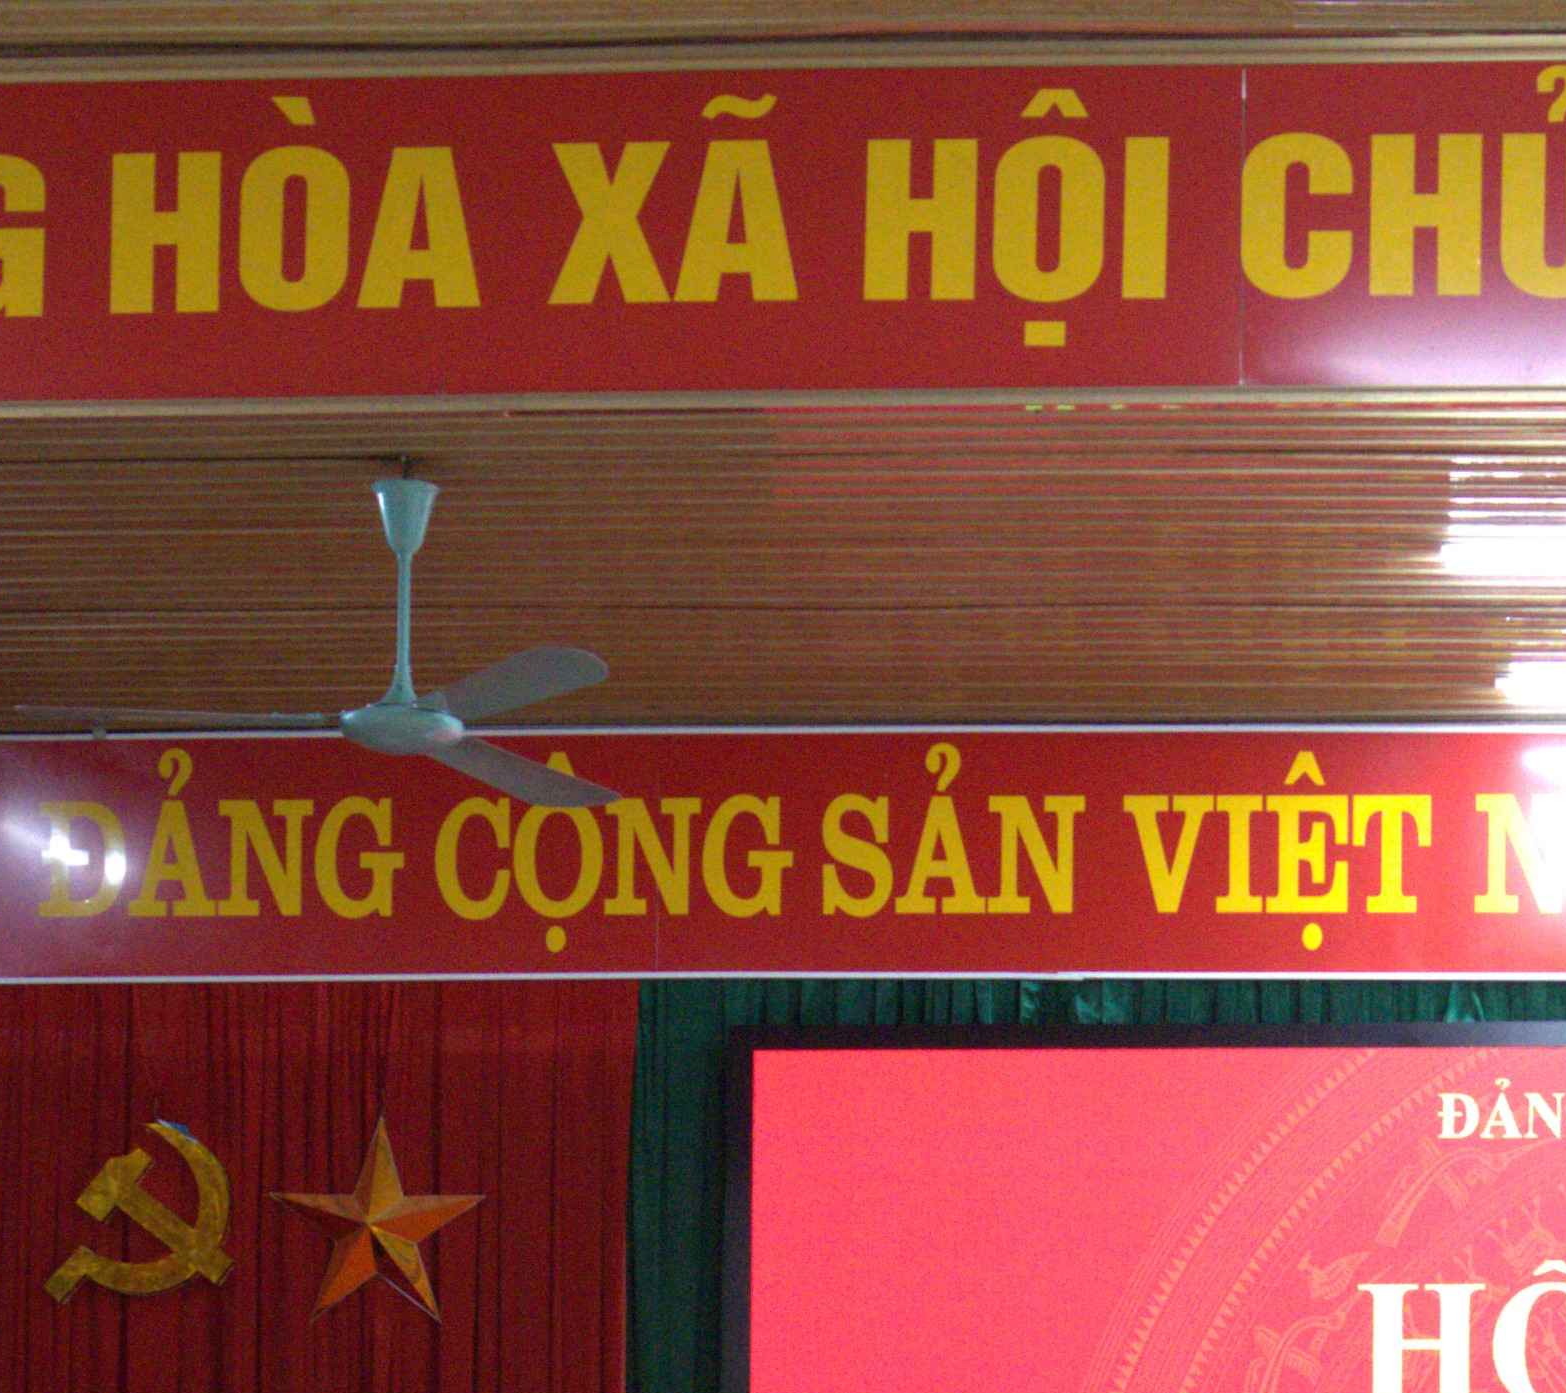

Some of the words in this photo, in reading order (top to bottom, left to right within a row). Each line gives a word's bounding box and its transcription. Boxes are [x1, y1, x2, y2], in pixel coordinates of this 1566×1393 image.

[109, 95, 481, 315] HÒA
[547, 93, 799, 305] XÃ
[862, 87, 1171, 347] HỘI
[38, 749, 405, 919] ĐẢNG
[434, 752, 794, 953] CỘNG
[821, 743, 1087, 918] SẢN
[1122, 750, 1433, 951] VIỆT
